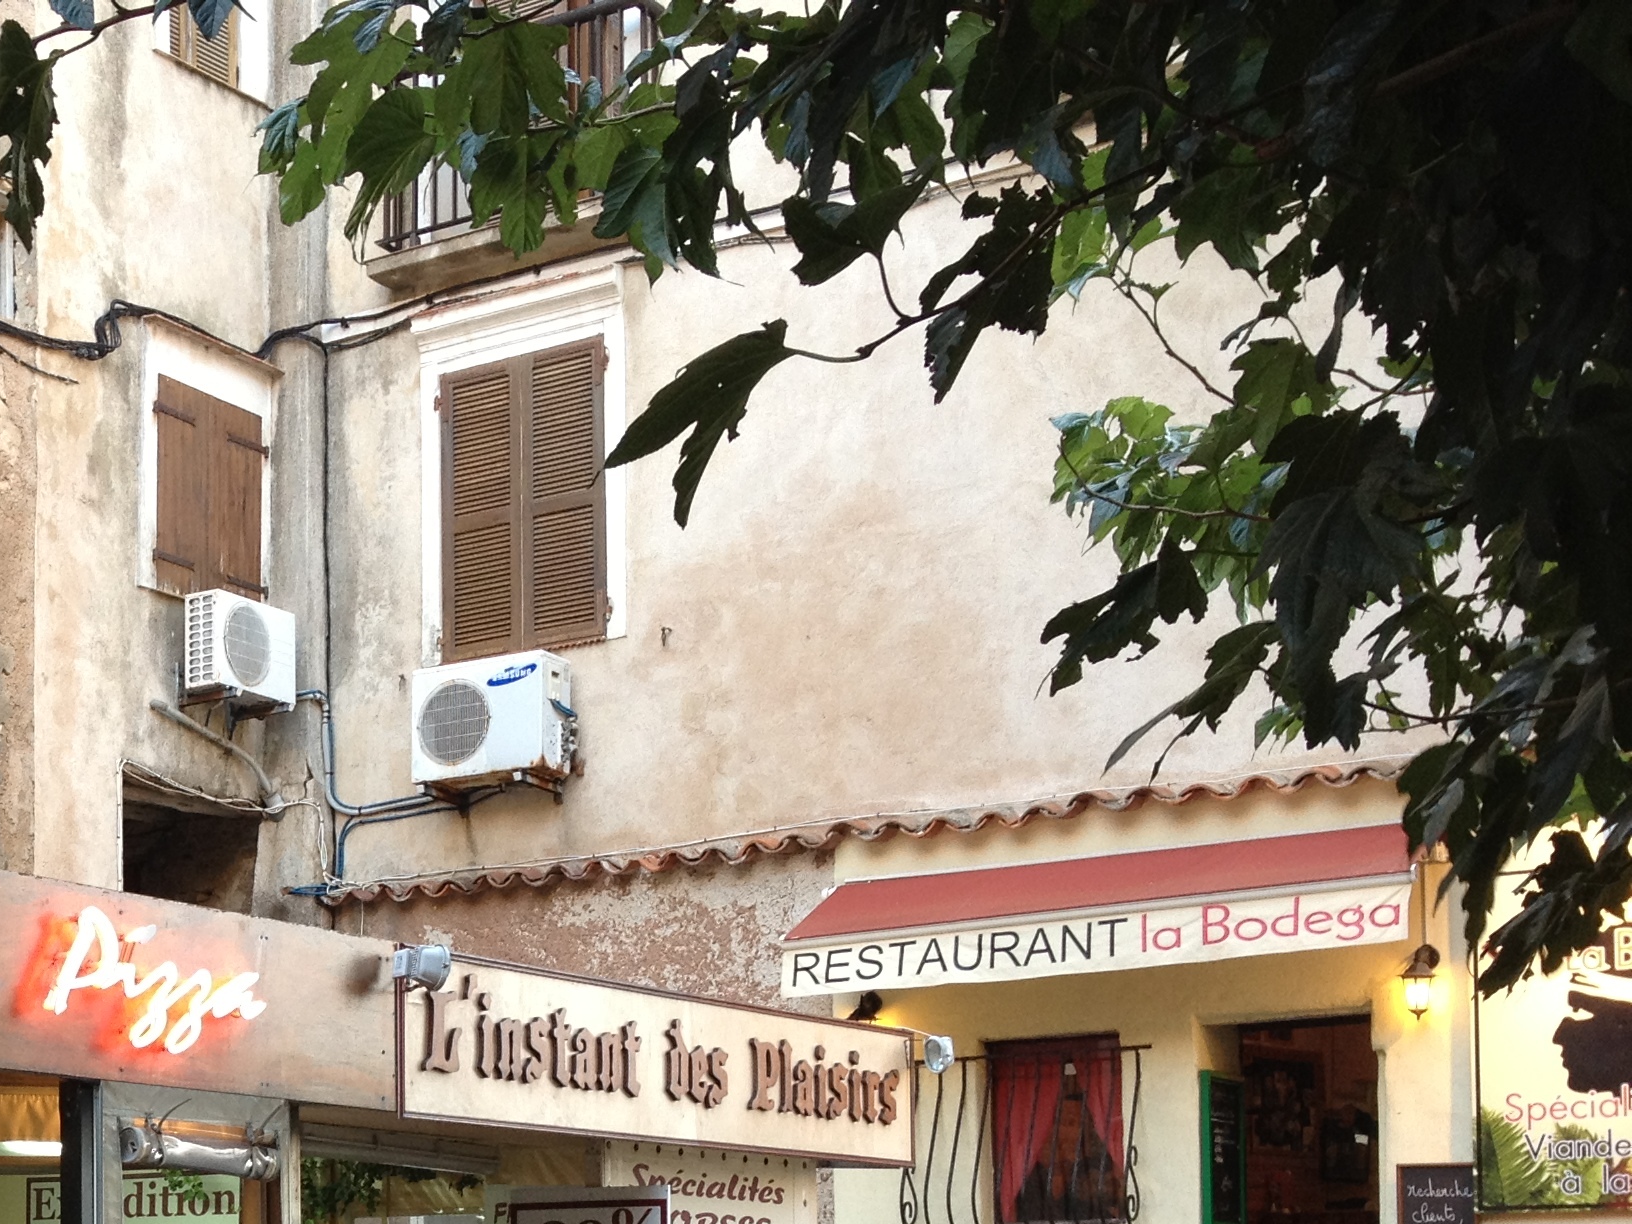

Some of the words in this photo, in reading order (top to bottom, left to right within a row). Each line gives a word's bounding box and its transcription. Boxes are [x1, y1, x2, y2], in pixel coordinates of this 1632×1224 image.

[42, 905, 267, 1054] Pizza
[792, 917, 1129, 988] RESTAURANT
[1139, 913, 1183, 953] la
[1200, 896, 1402, 949] Bodega
[422, 976, 642, 1099] L'instant
[665, 1019, 729, 1108] des
[750, 1036, 900, 1127] Plaisirs
[631, 1163, 785, 1206] Spécialités
[1407, 1177, 1473, 1198] recherche
